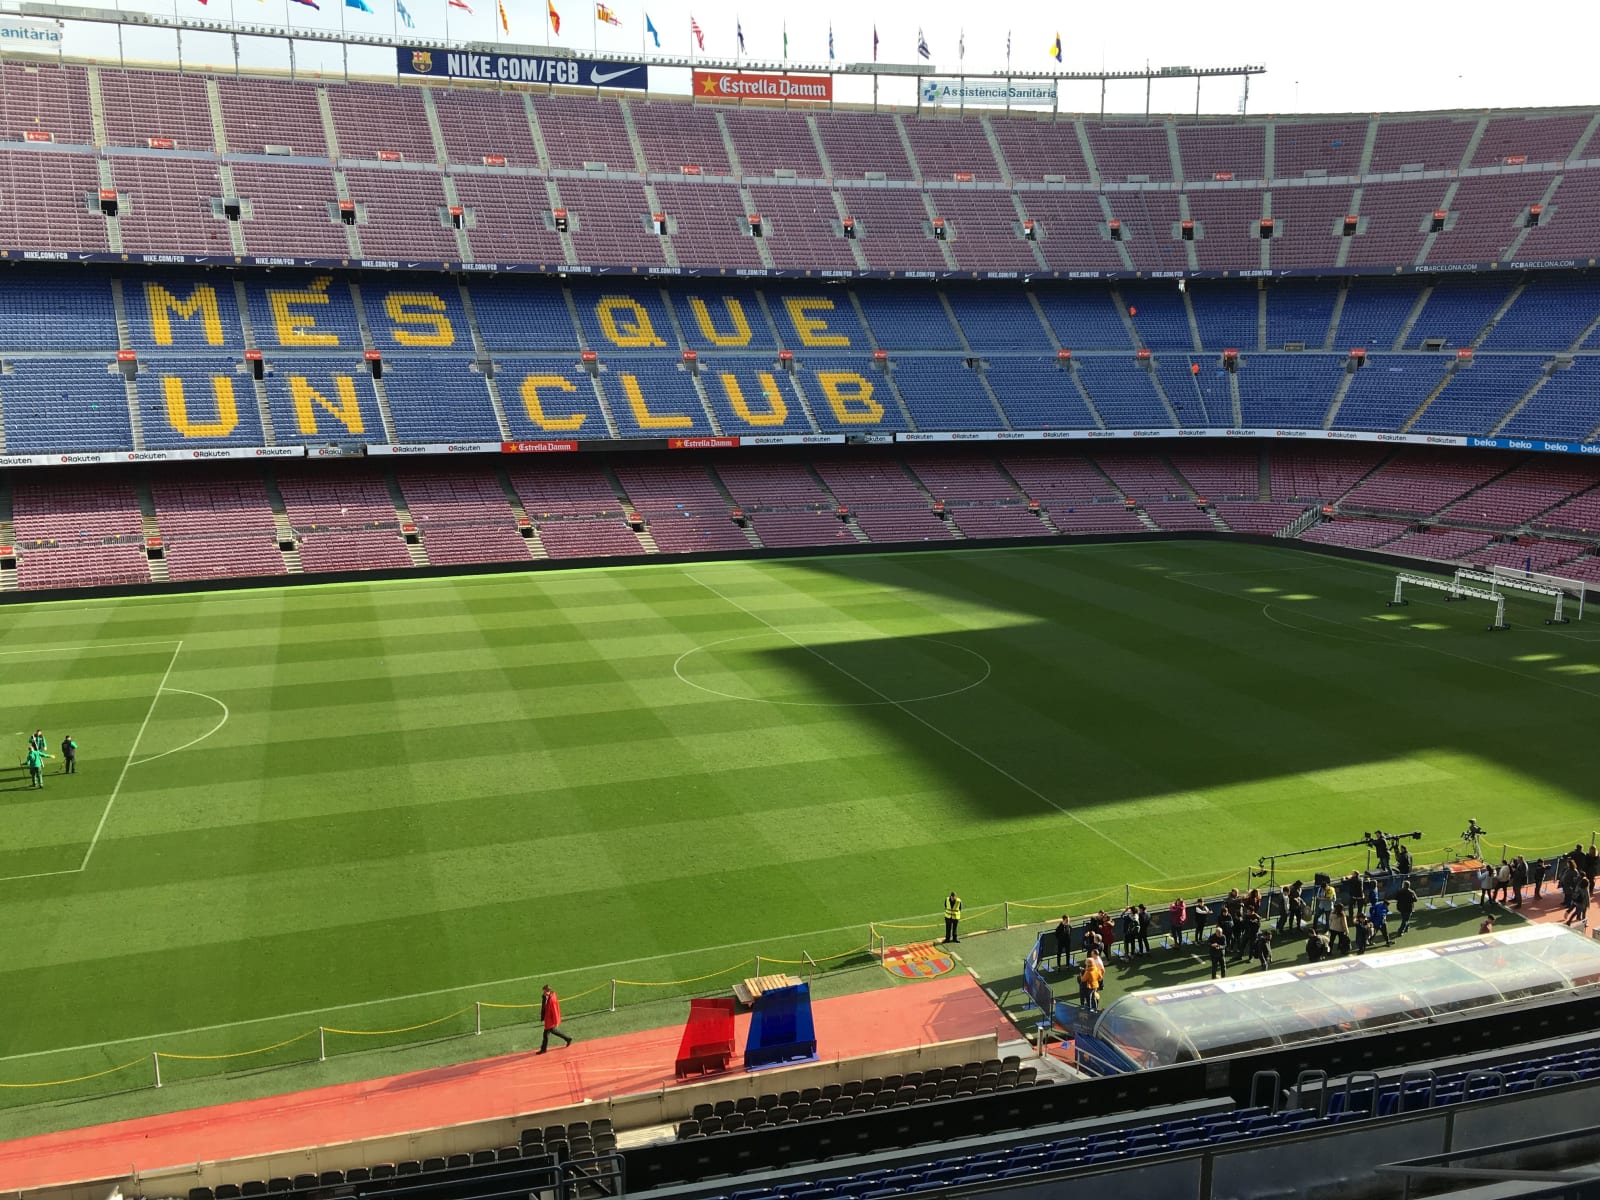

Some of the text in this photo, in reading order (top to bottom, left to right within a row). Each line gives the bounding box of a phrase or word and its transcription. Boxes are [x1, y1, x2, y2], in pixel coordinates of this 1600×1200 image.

[448, 53, 579, 83] NIKE.COM/FCB
[719, 75, 826, 97] Estrella Damm
[24, 251, 68, 260] NIKE.COM/FCB
[143, 254, 185, 263] NIKE.COM/FCB
[255, 257, 295, 265] NIKE.COM/FCB
[147, 276, 851, 347] MÉS QUE
[163, 372, 885, 438] UN CLUB
[518, 442, 571, 452] Estrella Damm
[683, 438, 732, 447] Estrella Damm
[1474, 438, 1497, 447] beko
[1509, 439, 1532, 449] beko
[1544, 441, 1568, 451] beko
[262, 448, 292, 456] Rakuten
[454, 444, 481, 452] Rakuten
[67, 454, 101, 463] Rakuten
[134, 452, 167, 460] Rakuten
[199, 450, 231, 458] Rakuten
